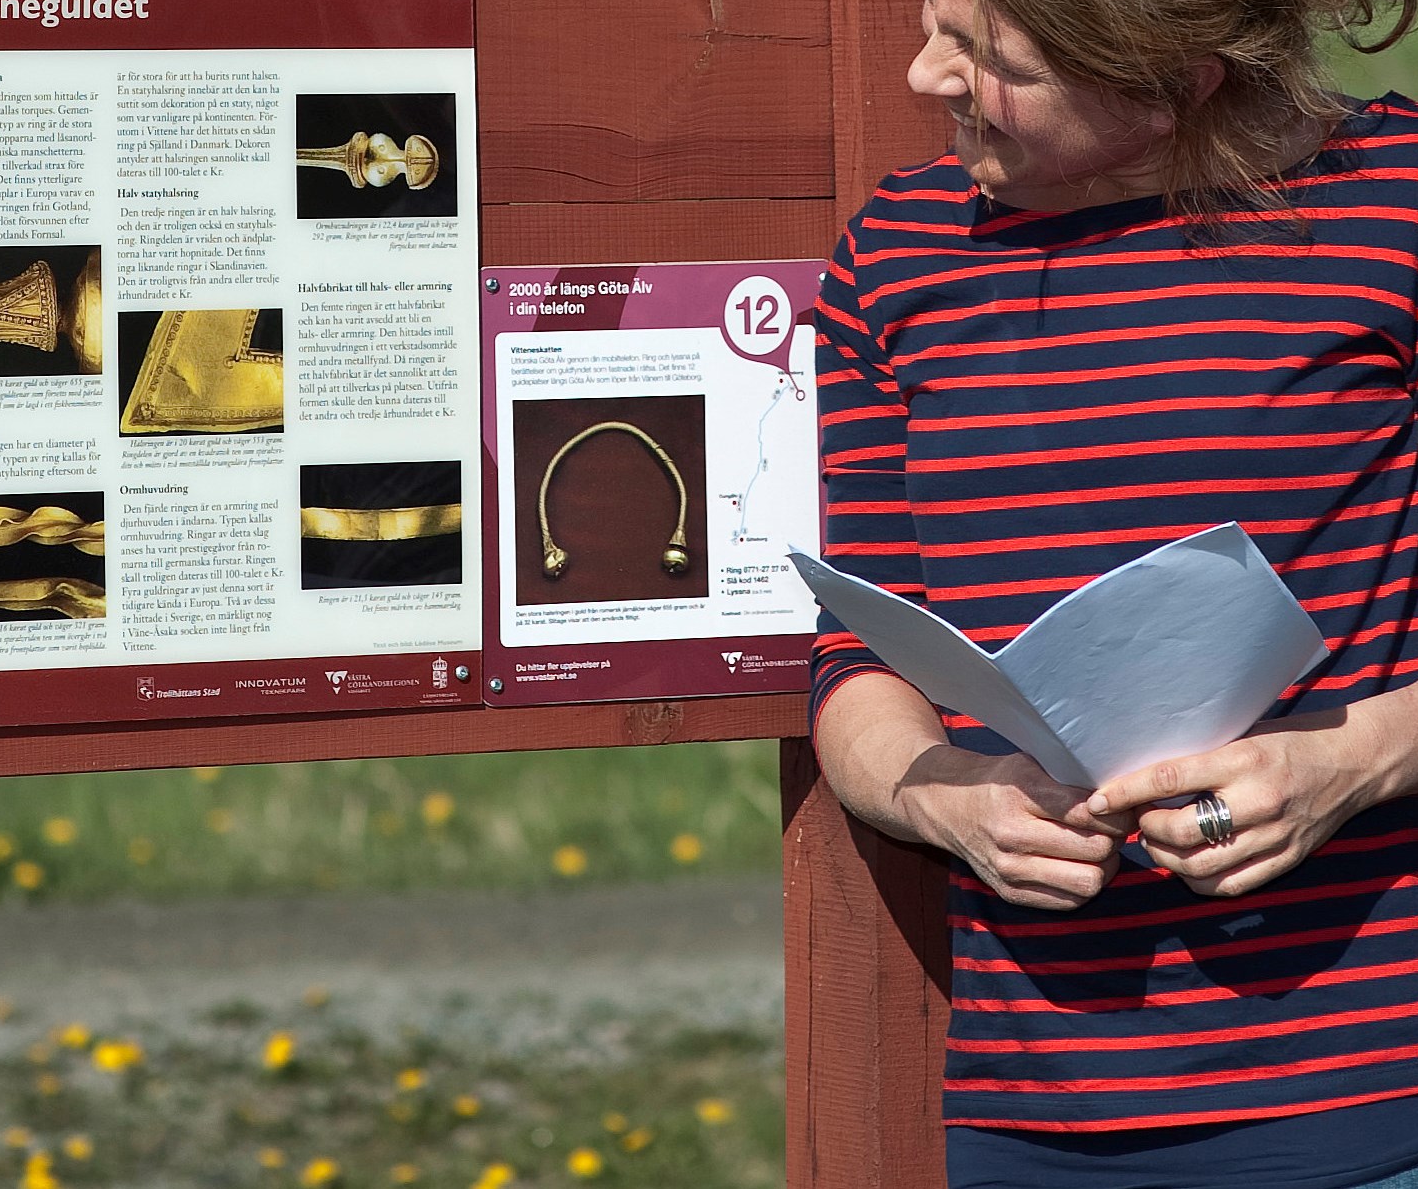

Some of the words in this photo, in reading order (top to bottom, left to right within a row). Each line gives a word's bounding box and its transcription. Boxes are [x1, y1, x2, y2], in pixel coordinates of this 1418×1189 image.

[1, 159, 42, 170] tillverkad
[44, 162, 65, 170] strax
[67, 159, 84, 169] före
[117, 188, 138, 198] Halv
[141, 187, 198, 200] statyhalsring
[298, 282, 352, 292] Halvfabrikat
[355, 281, 367, 291] till
[370, 281, 391, 291] hals-
[394, 281, 414, 291] eller
[416, 283, 452, 292] armring
[508, 282, 541, 296] 2000
[543, 282, 558, 295] år
[559, 281, 595, 297] längs
[597, 281, 629, 294] Göta
[631, 277, 652, 293] Älv
[509, 301, 513, 315] i
[515, 301, 537, 315] din
[537, 300, 584, 314] telefon
[735, 294, 779, 334] 12
[119, 483, 188, 495] Ormhuvudring
[235, 677, 305, 688] INNOVATUM
